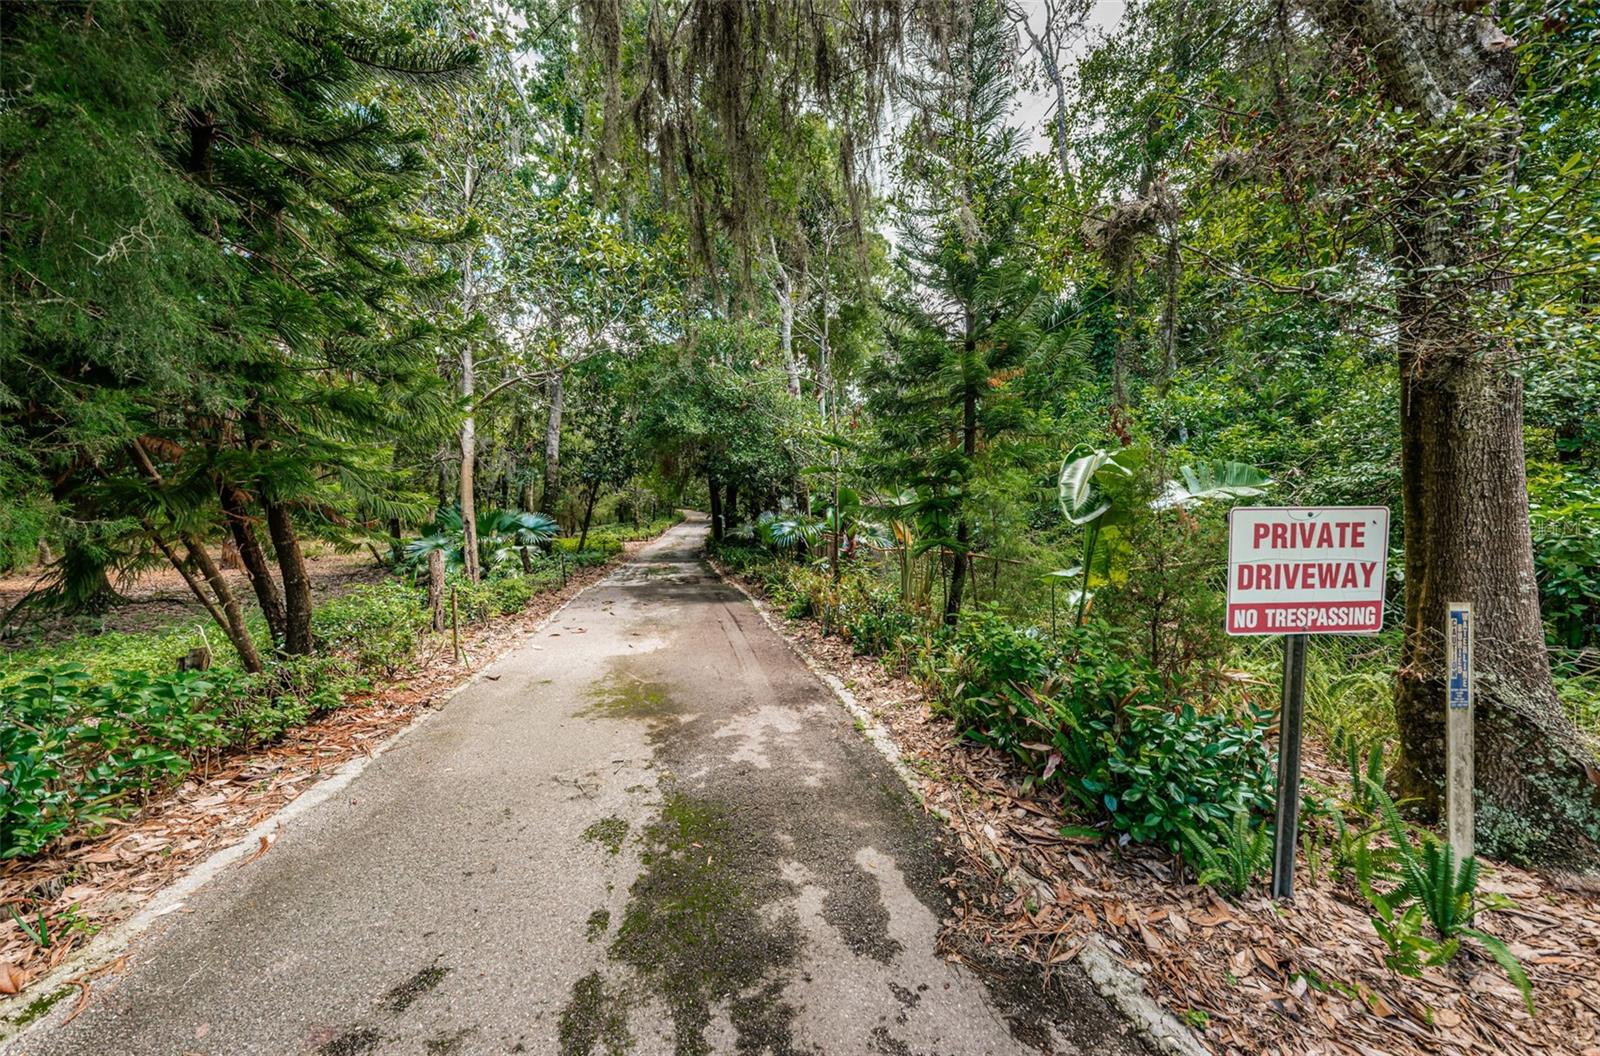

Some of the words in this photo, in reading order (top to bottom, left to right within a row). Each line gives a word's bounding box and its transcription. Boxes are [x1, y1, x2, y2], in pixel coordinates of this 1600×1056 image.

[1253, 522, 1366, 549] PRIVATE
[1237, 562, 1377, 590] DRIVEWAY
[1234, 609, 1258, 628] NO
[1265, 606, 1376, 628] TRESPASSING
